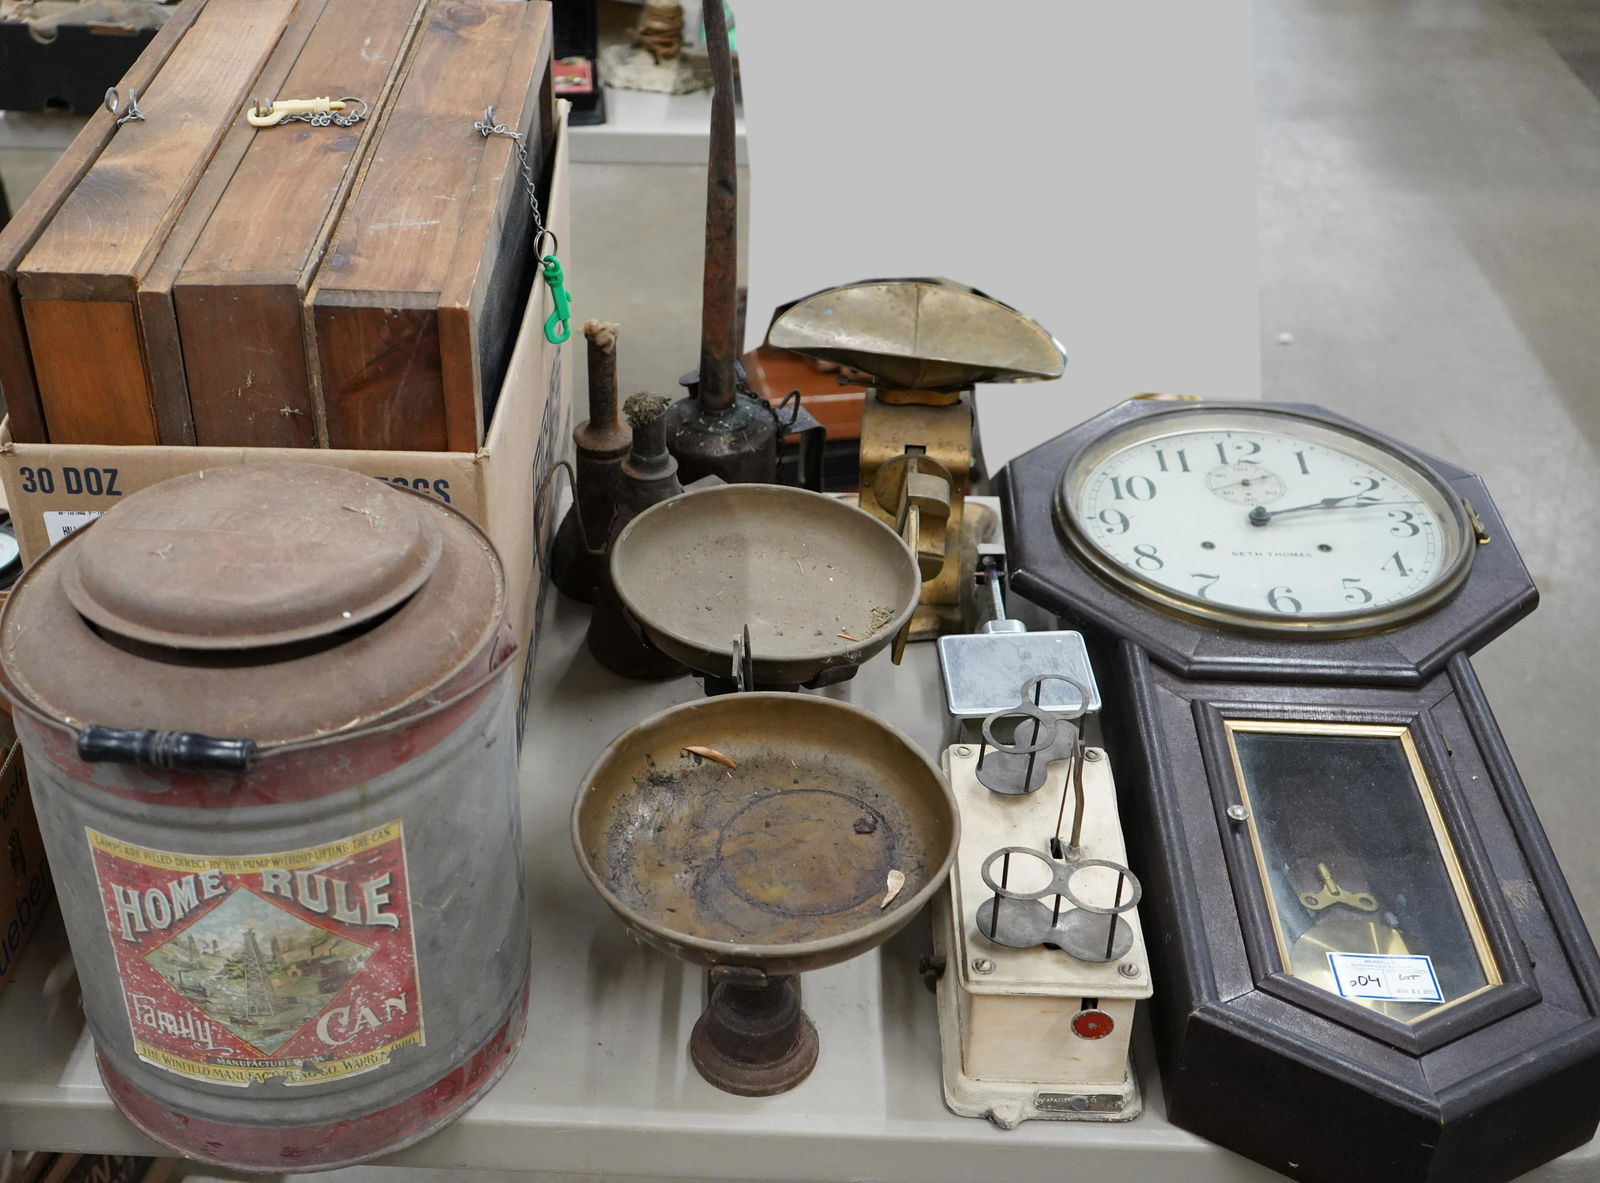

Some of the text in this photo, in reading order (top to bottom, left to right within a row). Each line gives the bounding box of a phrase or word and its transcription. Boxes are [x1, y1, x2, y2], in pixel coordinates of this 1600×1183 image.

[1155, 448, 1192, 473] 11
[1215, 440, 1262, 466] 12
[1295, 449, 1311, 475] 1
[19, 466, 55, 494] 30
[62, 467, 123, 496] DOZ
[1109, 475, 1157, 501] 10
[1350, 475, 1384, 502] 2
[1098, 507, 1130, 535] 9
[1387, 510, 1420, 538] 3
[1133, 543, 1165, 571] 8
[1380, 551, 1414, 577] 4
[1190, 572, 1221, 601] 7
[1267, 585, 1303, 613] 6
[1341, 577, 1373, 604] 5
[144, 851, 172, 865] FILLED
[243, 858, 271, 869] PUMP
[371, 829, 392, 843] CAN
[110, 868, 400, 943] HOME RULE
[131, 992, 409, 1057] Family CAN
[142, 1047, 160, 1060] THE
[160, 1053, 211, 1076] WINFIELD
